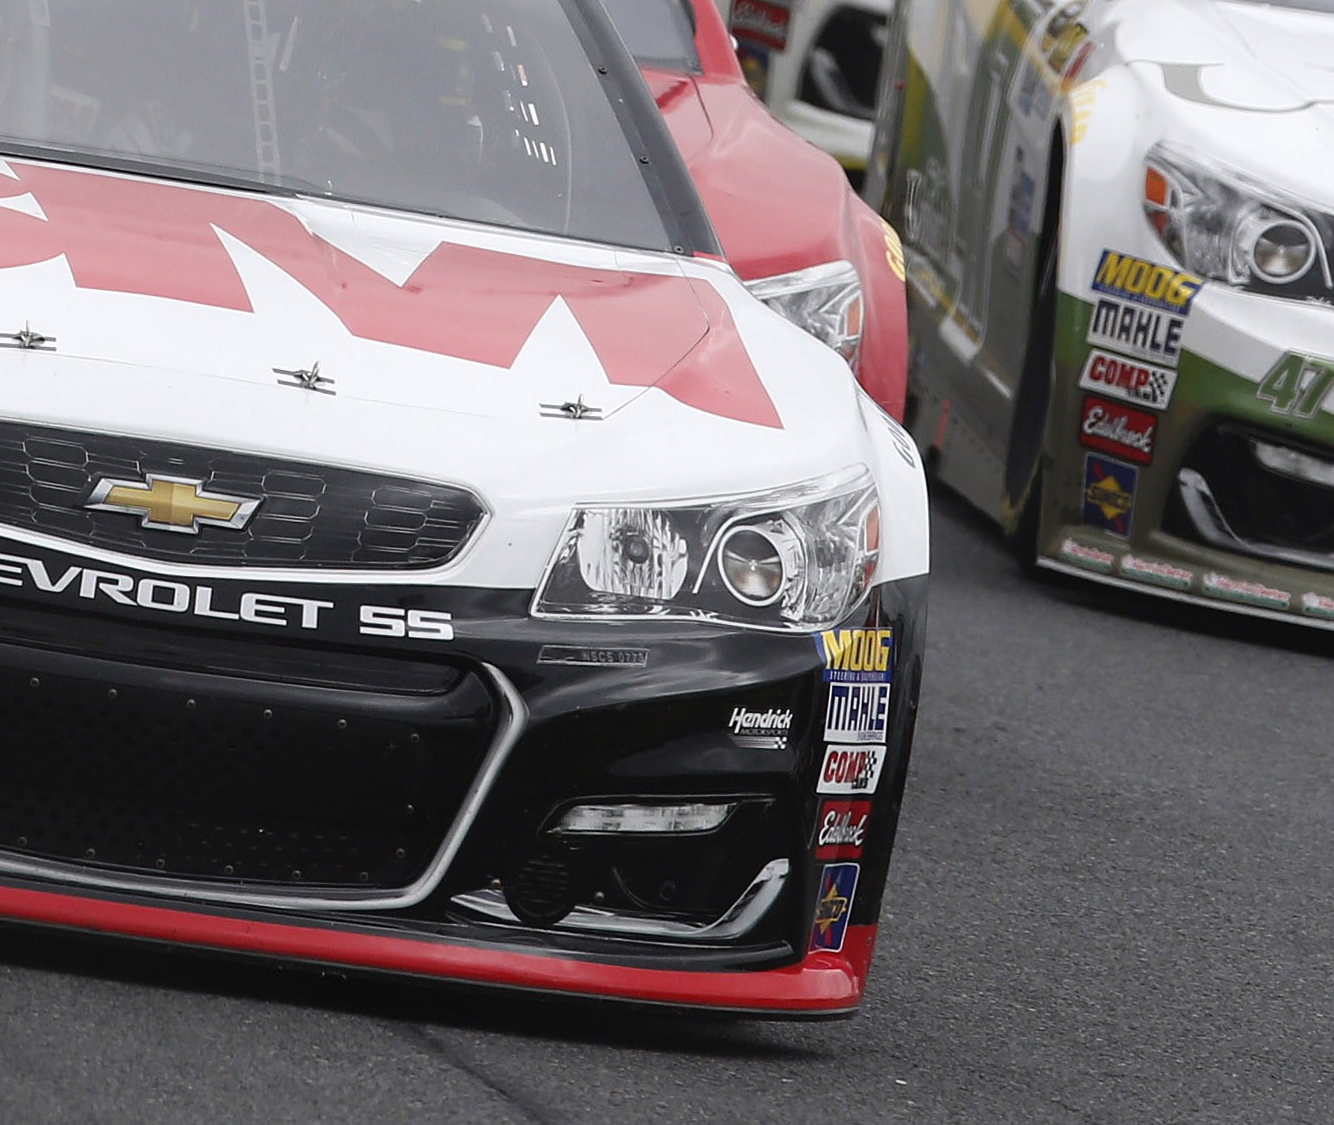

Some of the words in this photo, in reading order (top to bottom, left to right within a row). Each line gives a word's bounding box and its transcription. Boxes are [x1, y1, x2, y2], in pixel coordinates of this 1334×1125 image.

[1096, 252, 1205, 307] MOOG
[1093, 300, 1185, 355] MAHLE
[1089, 356, 1151, 391] COMP
[359, 605, 455, 641] SS
[821, 630, 891, 672] MOOG
[728, 707, 793, 734] Hendrick
[827, 686, 888, 731] MAHLE
[823, 751, 867, 784] COMP
